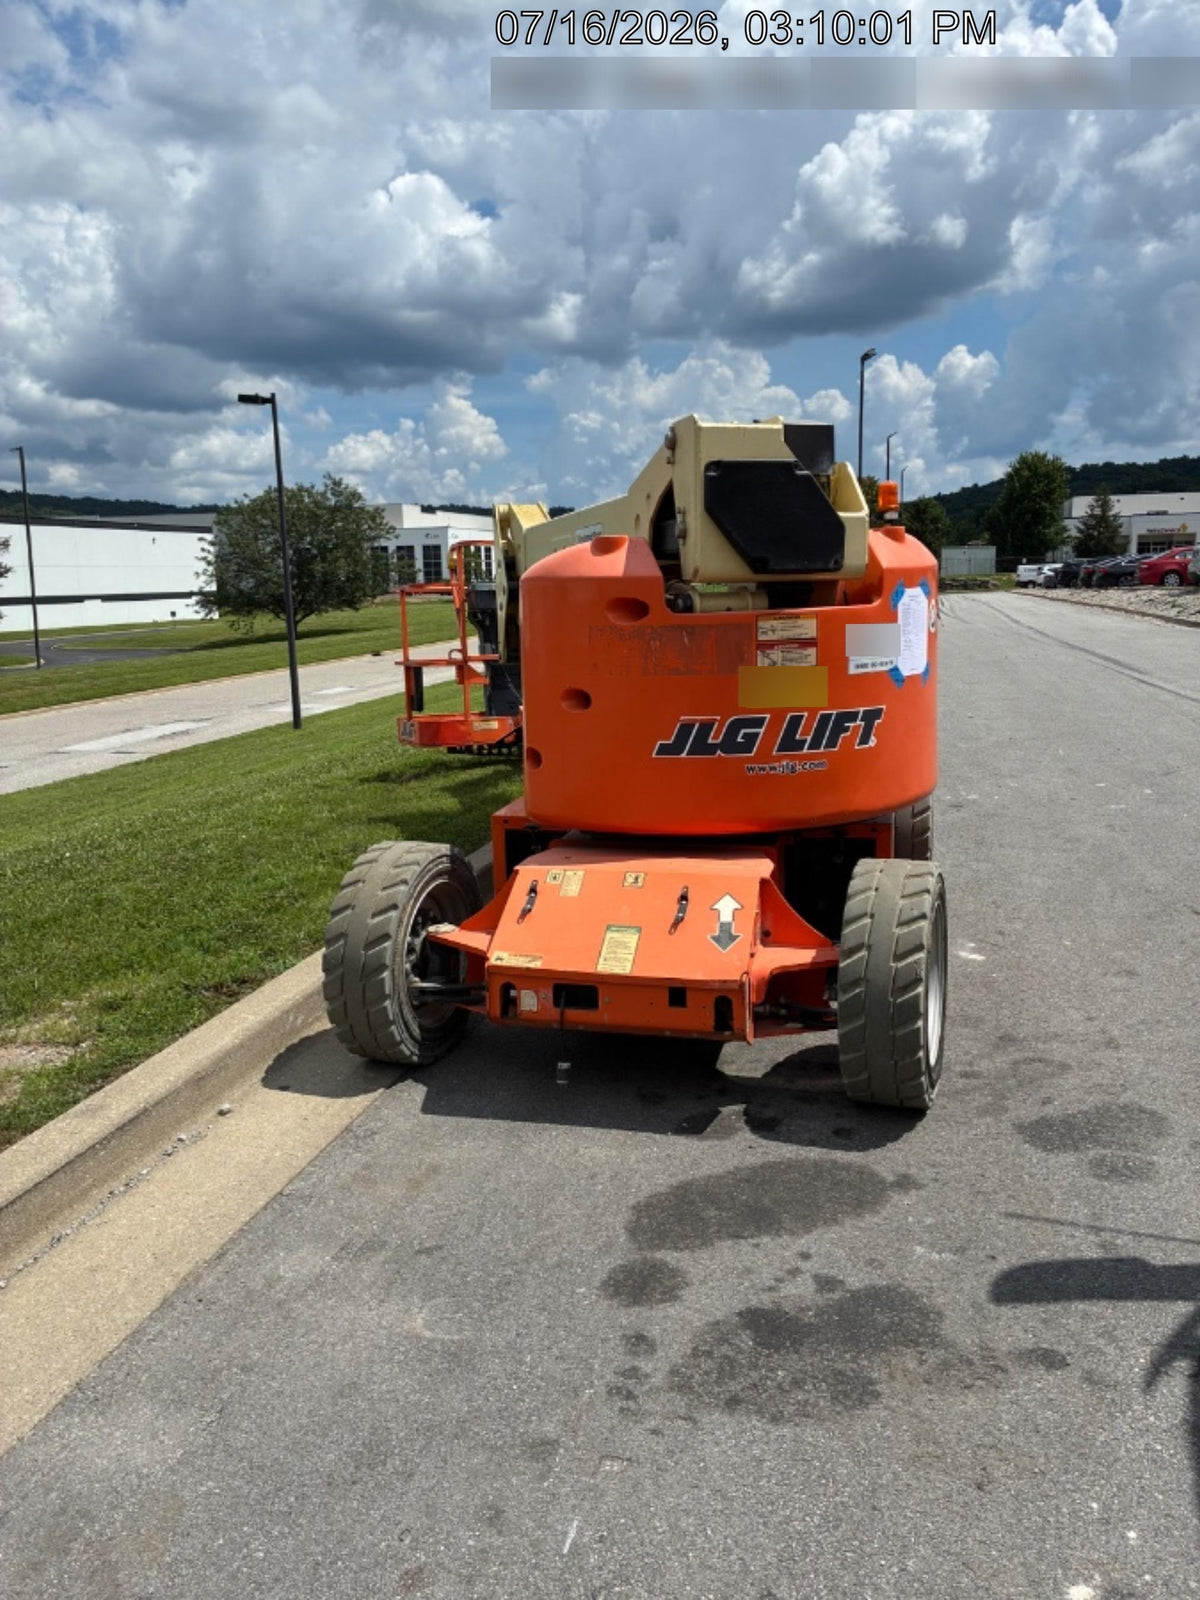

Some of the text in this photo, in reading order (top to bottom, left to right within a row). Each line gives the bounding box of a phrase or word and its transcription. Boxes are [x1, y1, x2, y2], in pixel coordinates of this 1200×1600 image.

[652, 705, 886, 757] JLG LIFT
[745, 759, 827, 775] www.jlg.com
